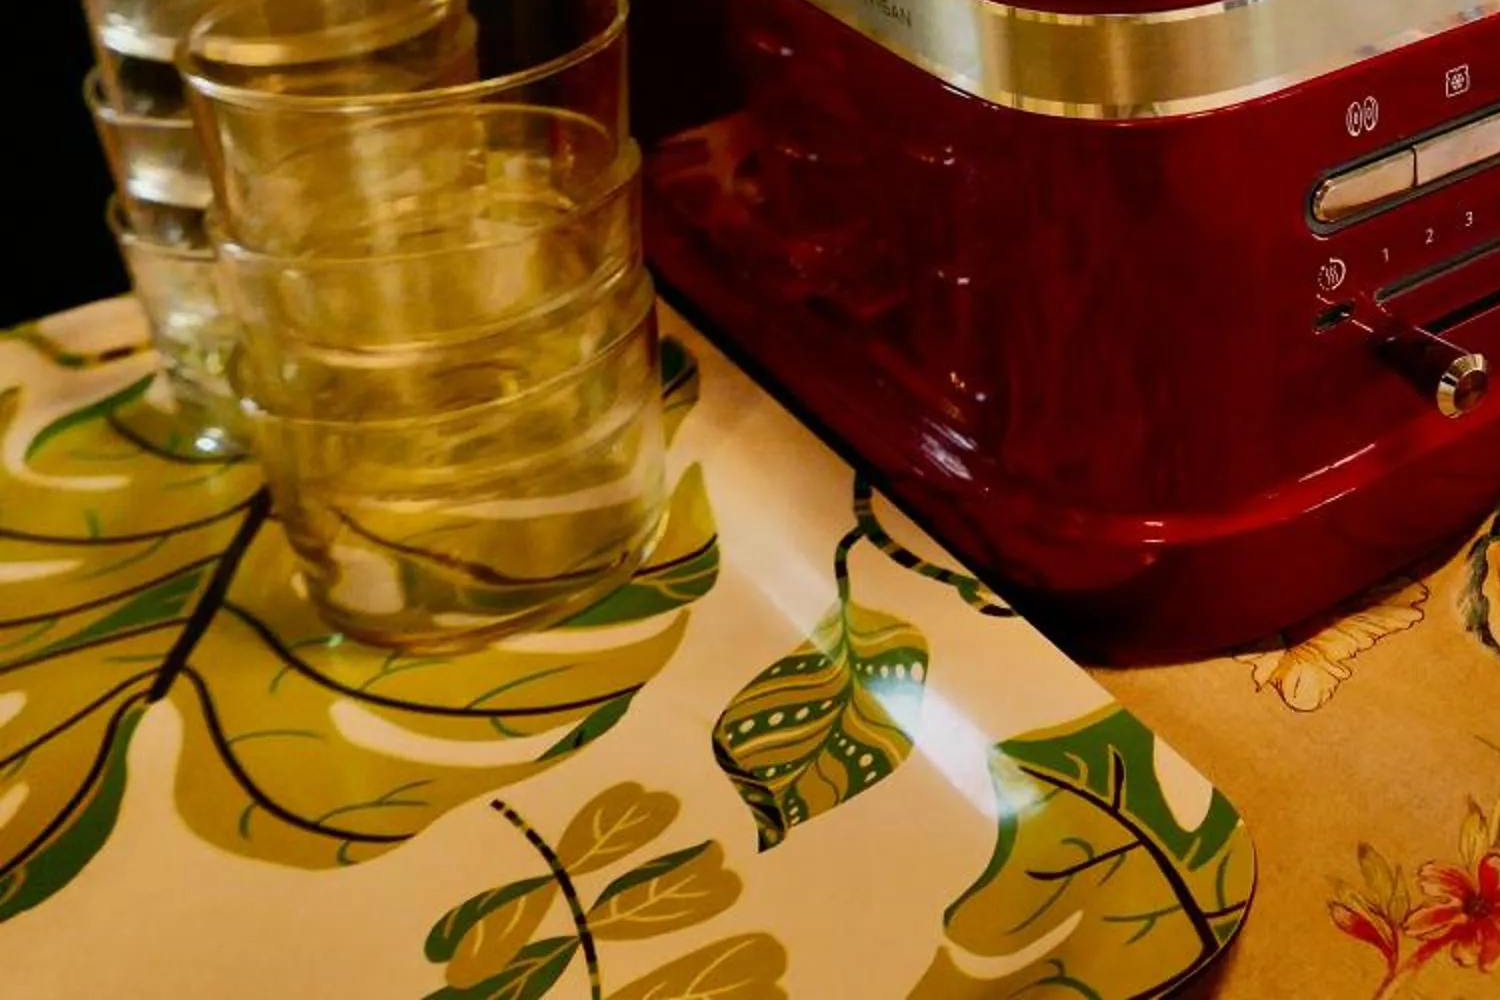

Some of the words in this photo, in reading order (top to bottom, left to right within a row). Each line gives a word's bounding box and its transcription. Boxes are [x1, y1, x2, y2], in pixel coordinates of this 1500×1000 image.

[1382, 247, 1390, 263] 1
[1425, 228, 1434, 244] 2
[1465, 211, 1473, 227] 3
